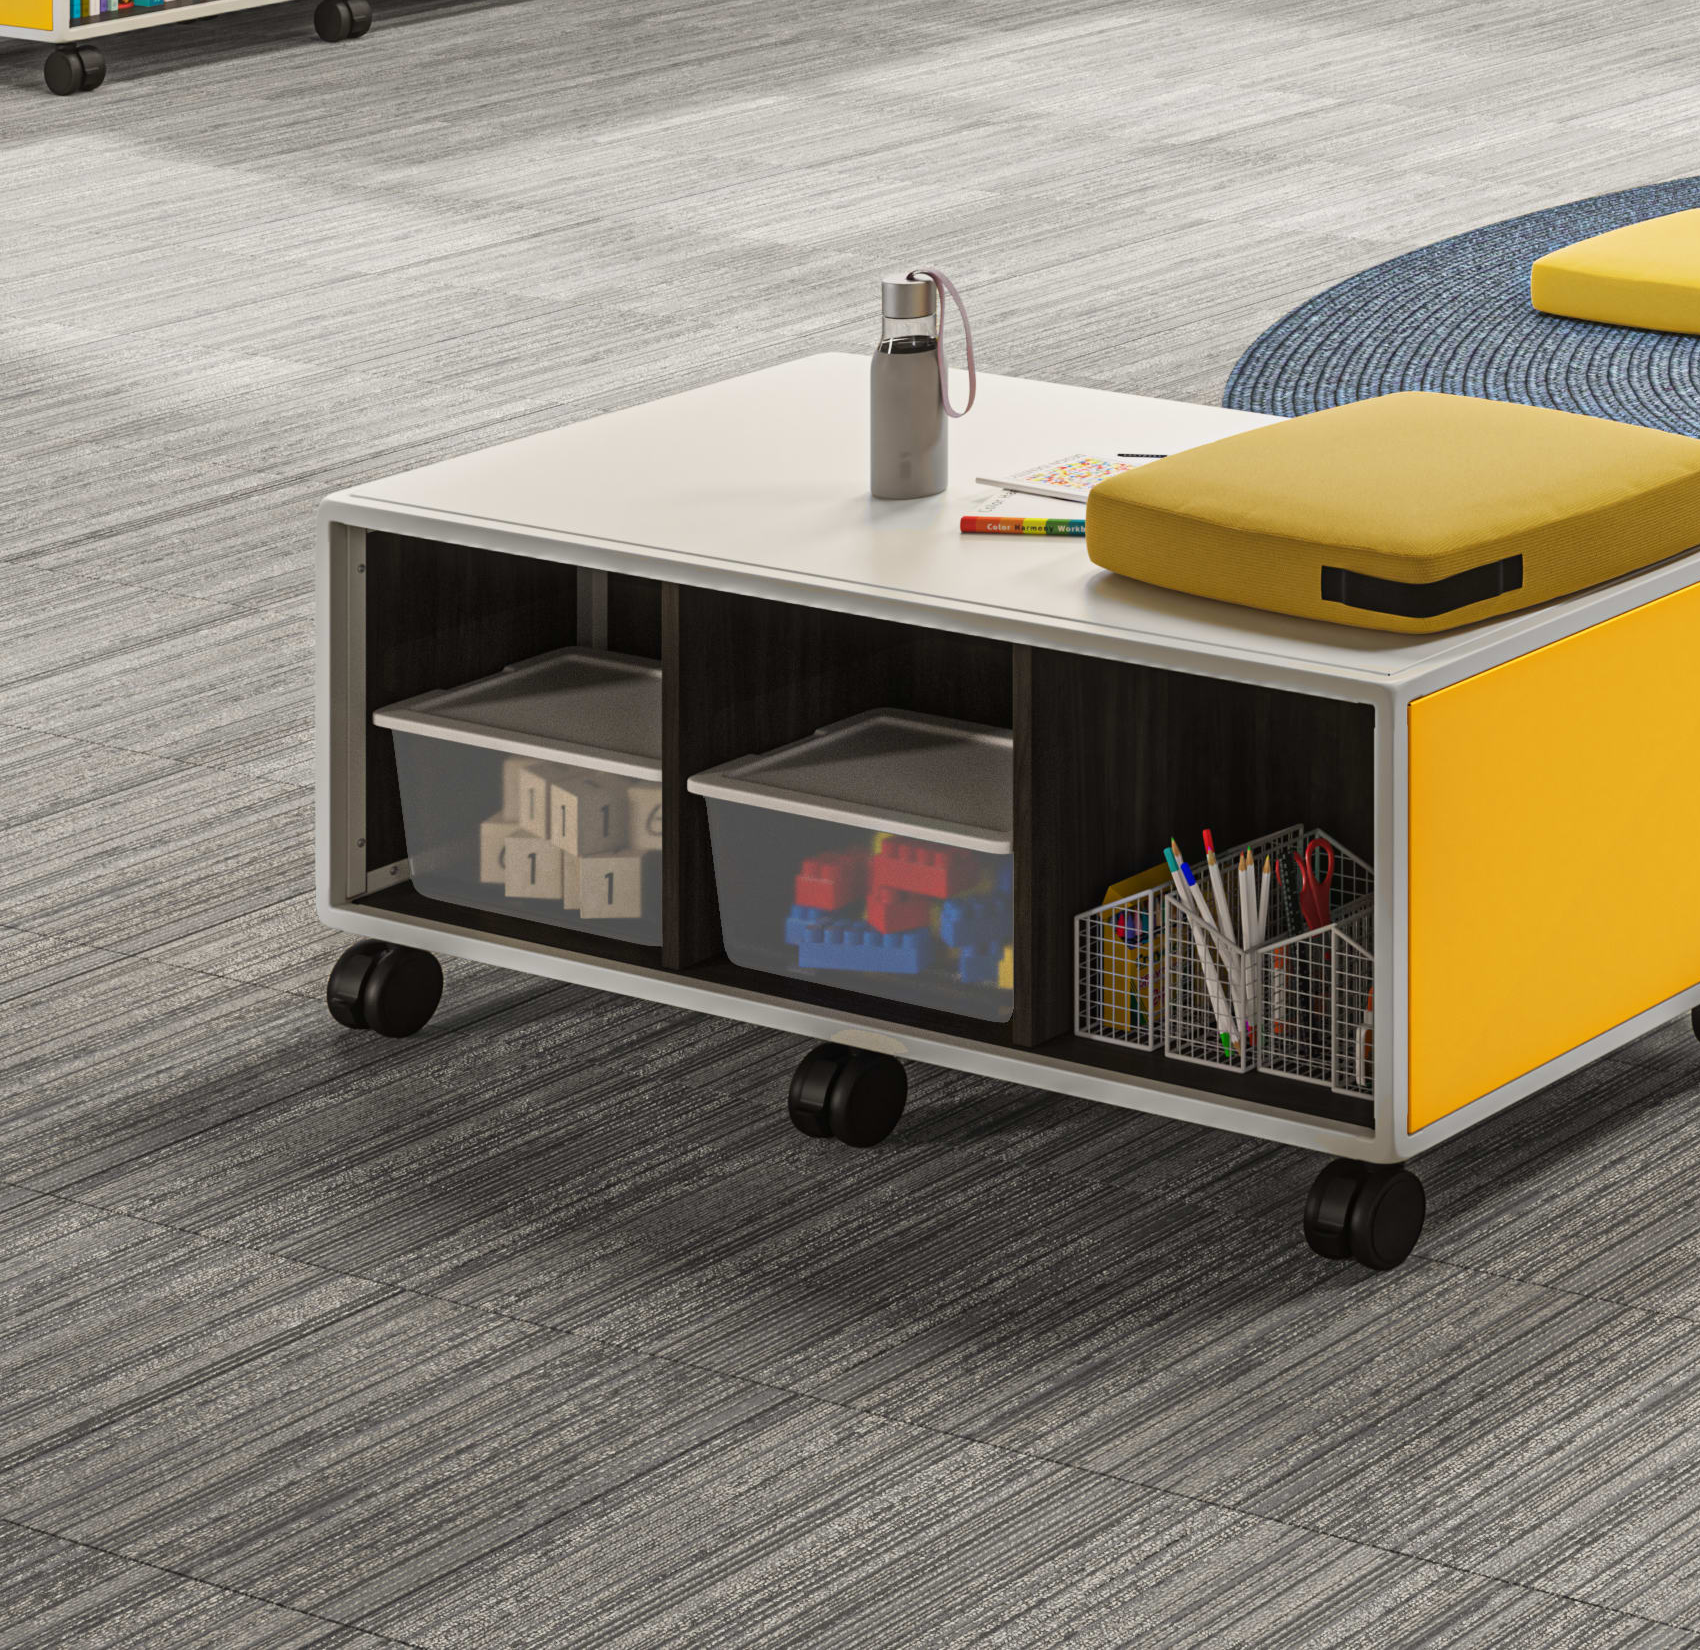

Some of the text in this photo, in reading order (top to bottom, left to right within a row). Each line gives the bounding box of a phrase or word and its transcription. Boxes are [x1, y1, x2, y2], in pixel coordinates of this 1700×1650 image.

[987, 523, 1011, 531] Color
[1015, 524, 1054, 533] Harmony
[601, 805, 609, 838] 1
[528, 853, 536, 885] 1
[604, 872, 614, 905] 1
